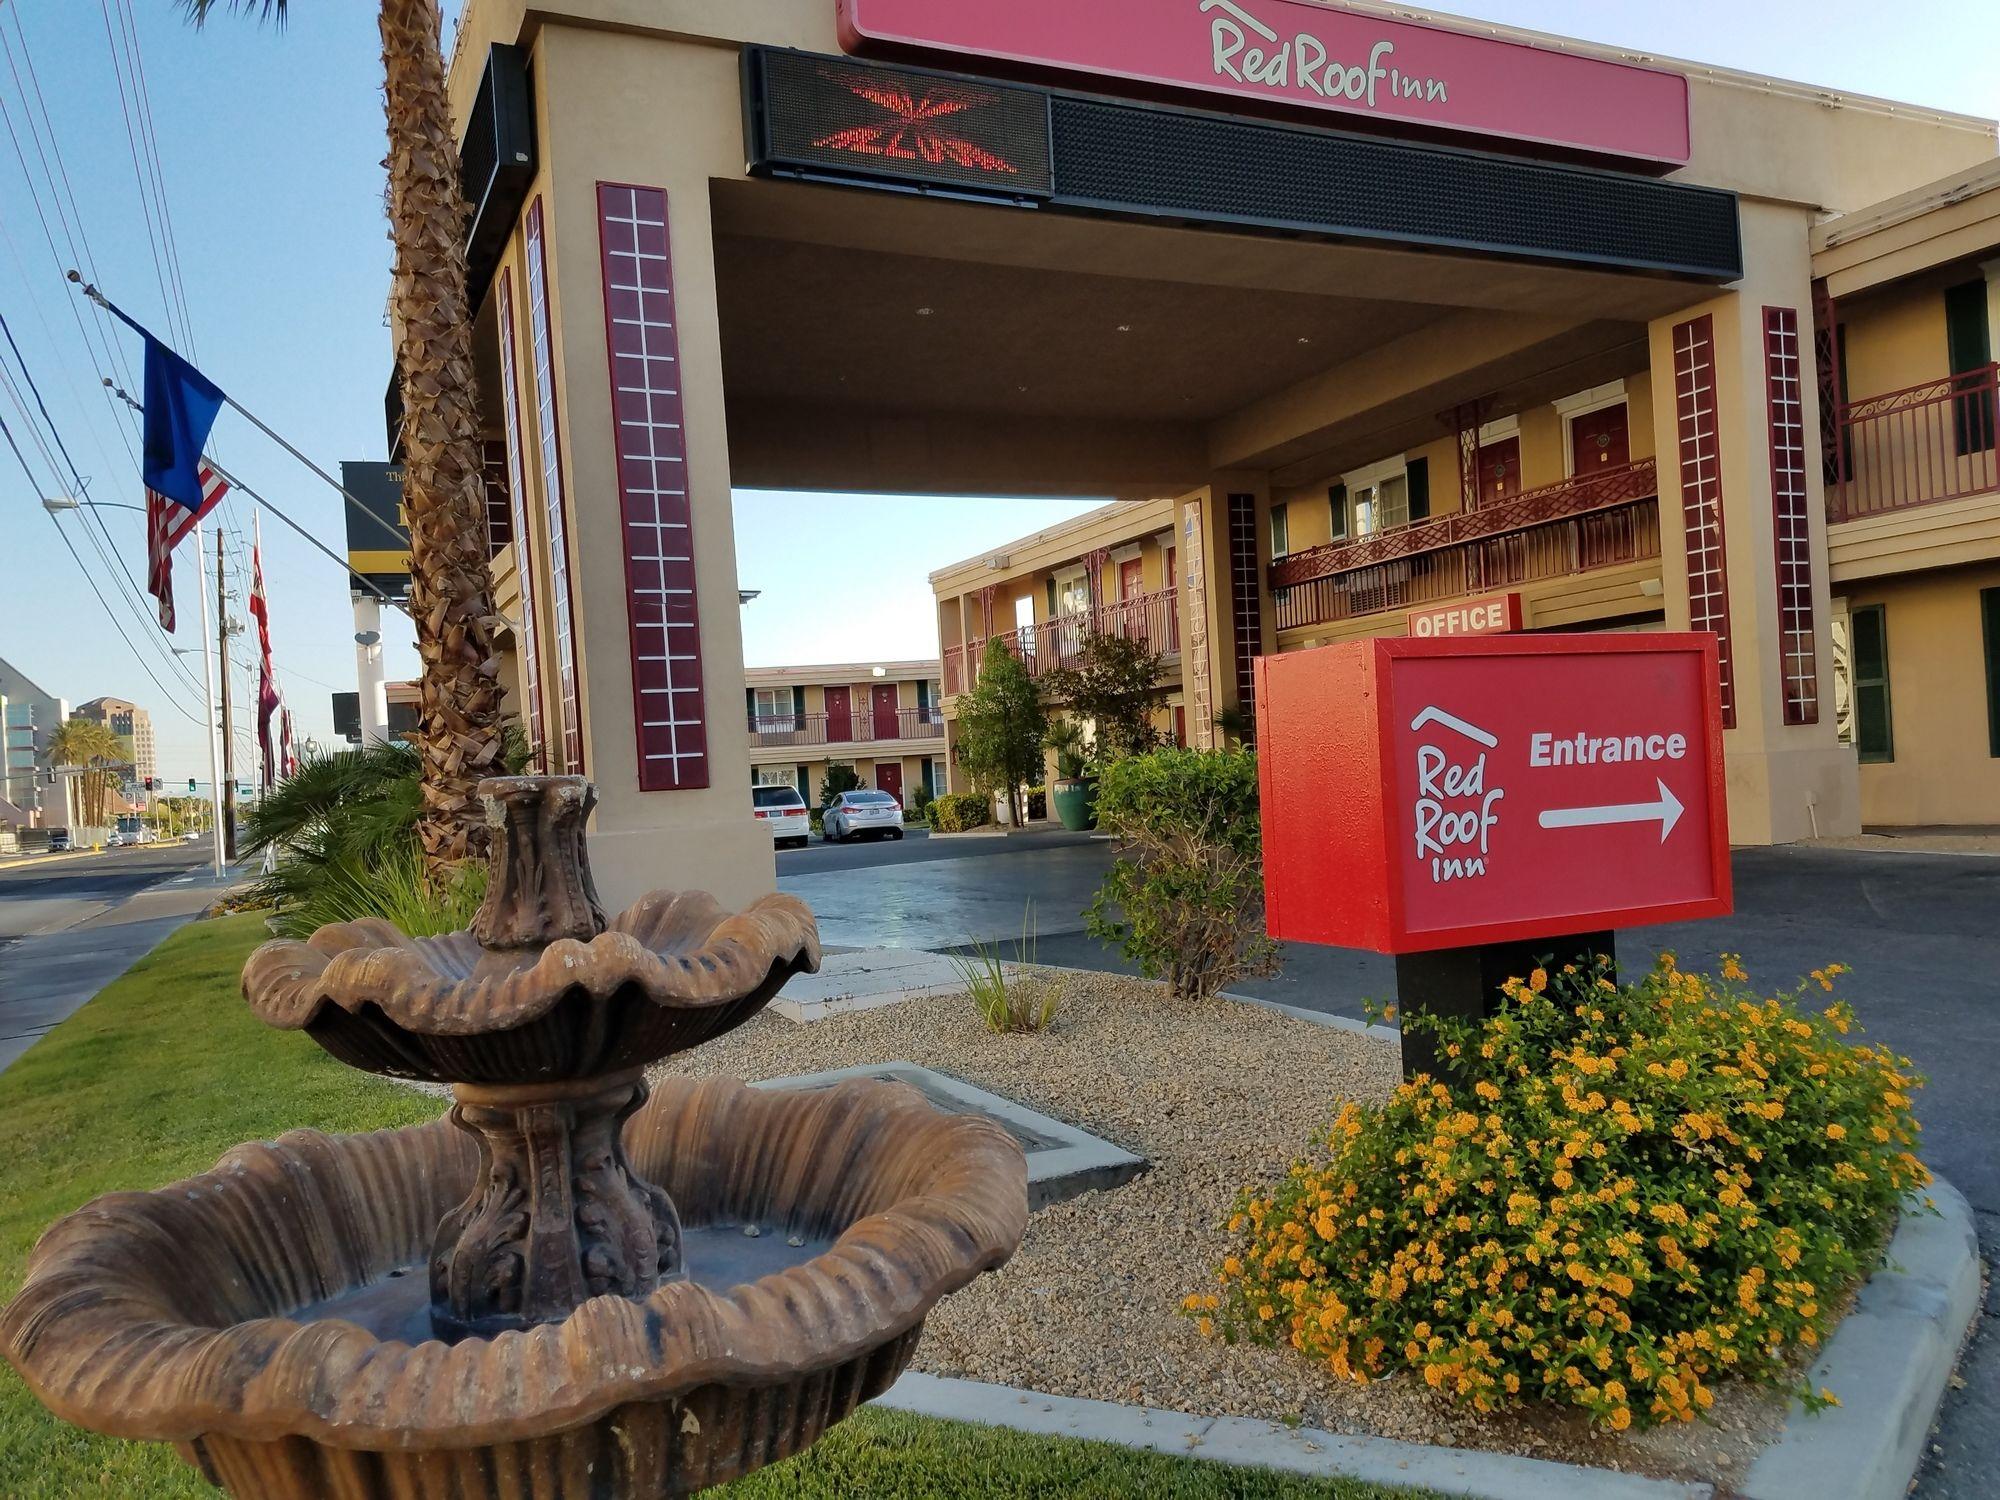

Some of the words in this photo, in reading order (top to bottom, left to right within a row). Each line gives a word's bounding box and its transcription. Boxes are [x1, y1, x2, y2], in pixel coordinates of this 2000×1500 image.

[1211, 18, 1291, 88] Red
[1295, 33, 1394, 107] Roof
[1416, 603, 1503, 638] OFFICE
[1417, 744, 1486, 801] Red
[1529, 732, 1687, 768] Entrance
[1414, 788, 1504, 860] Roof
